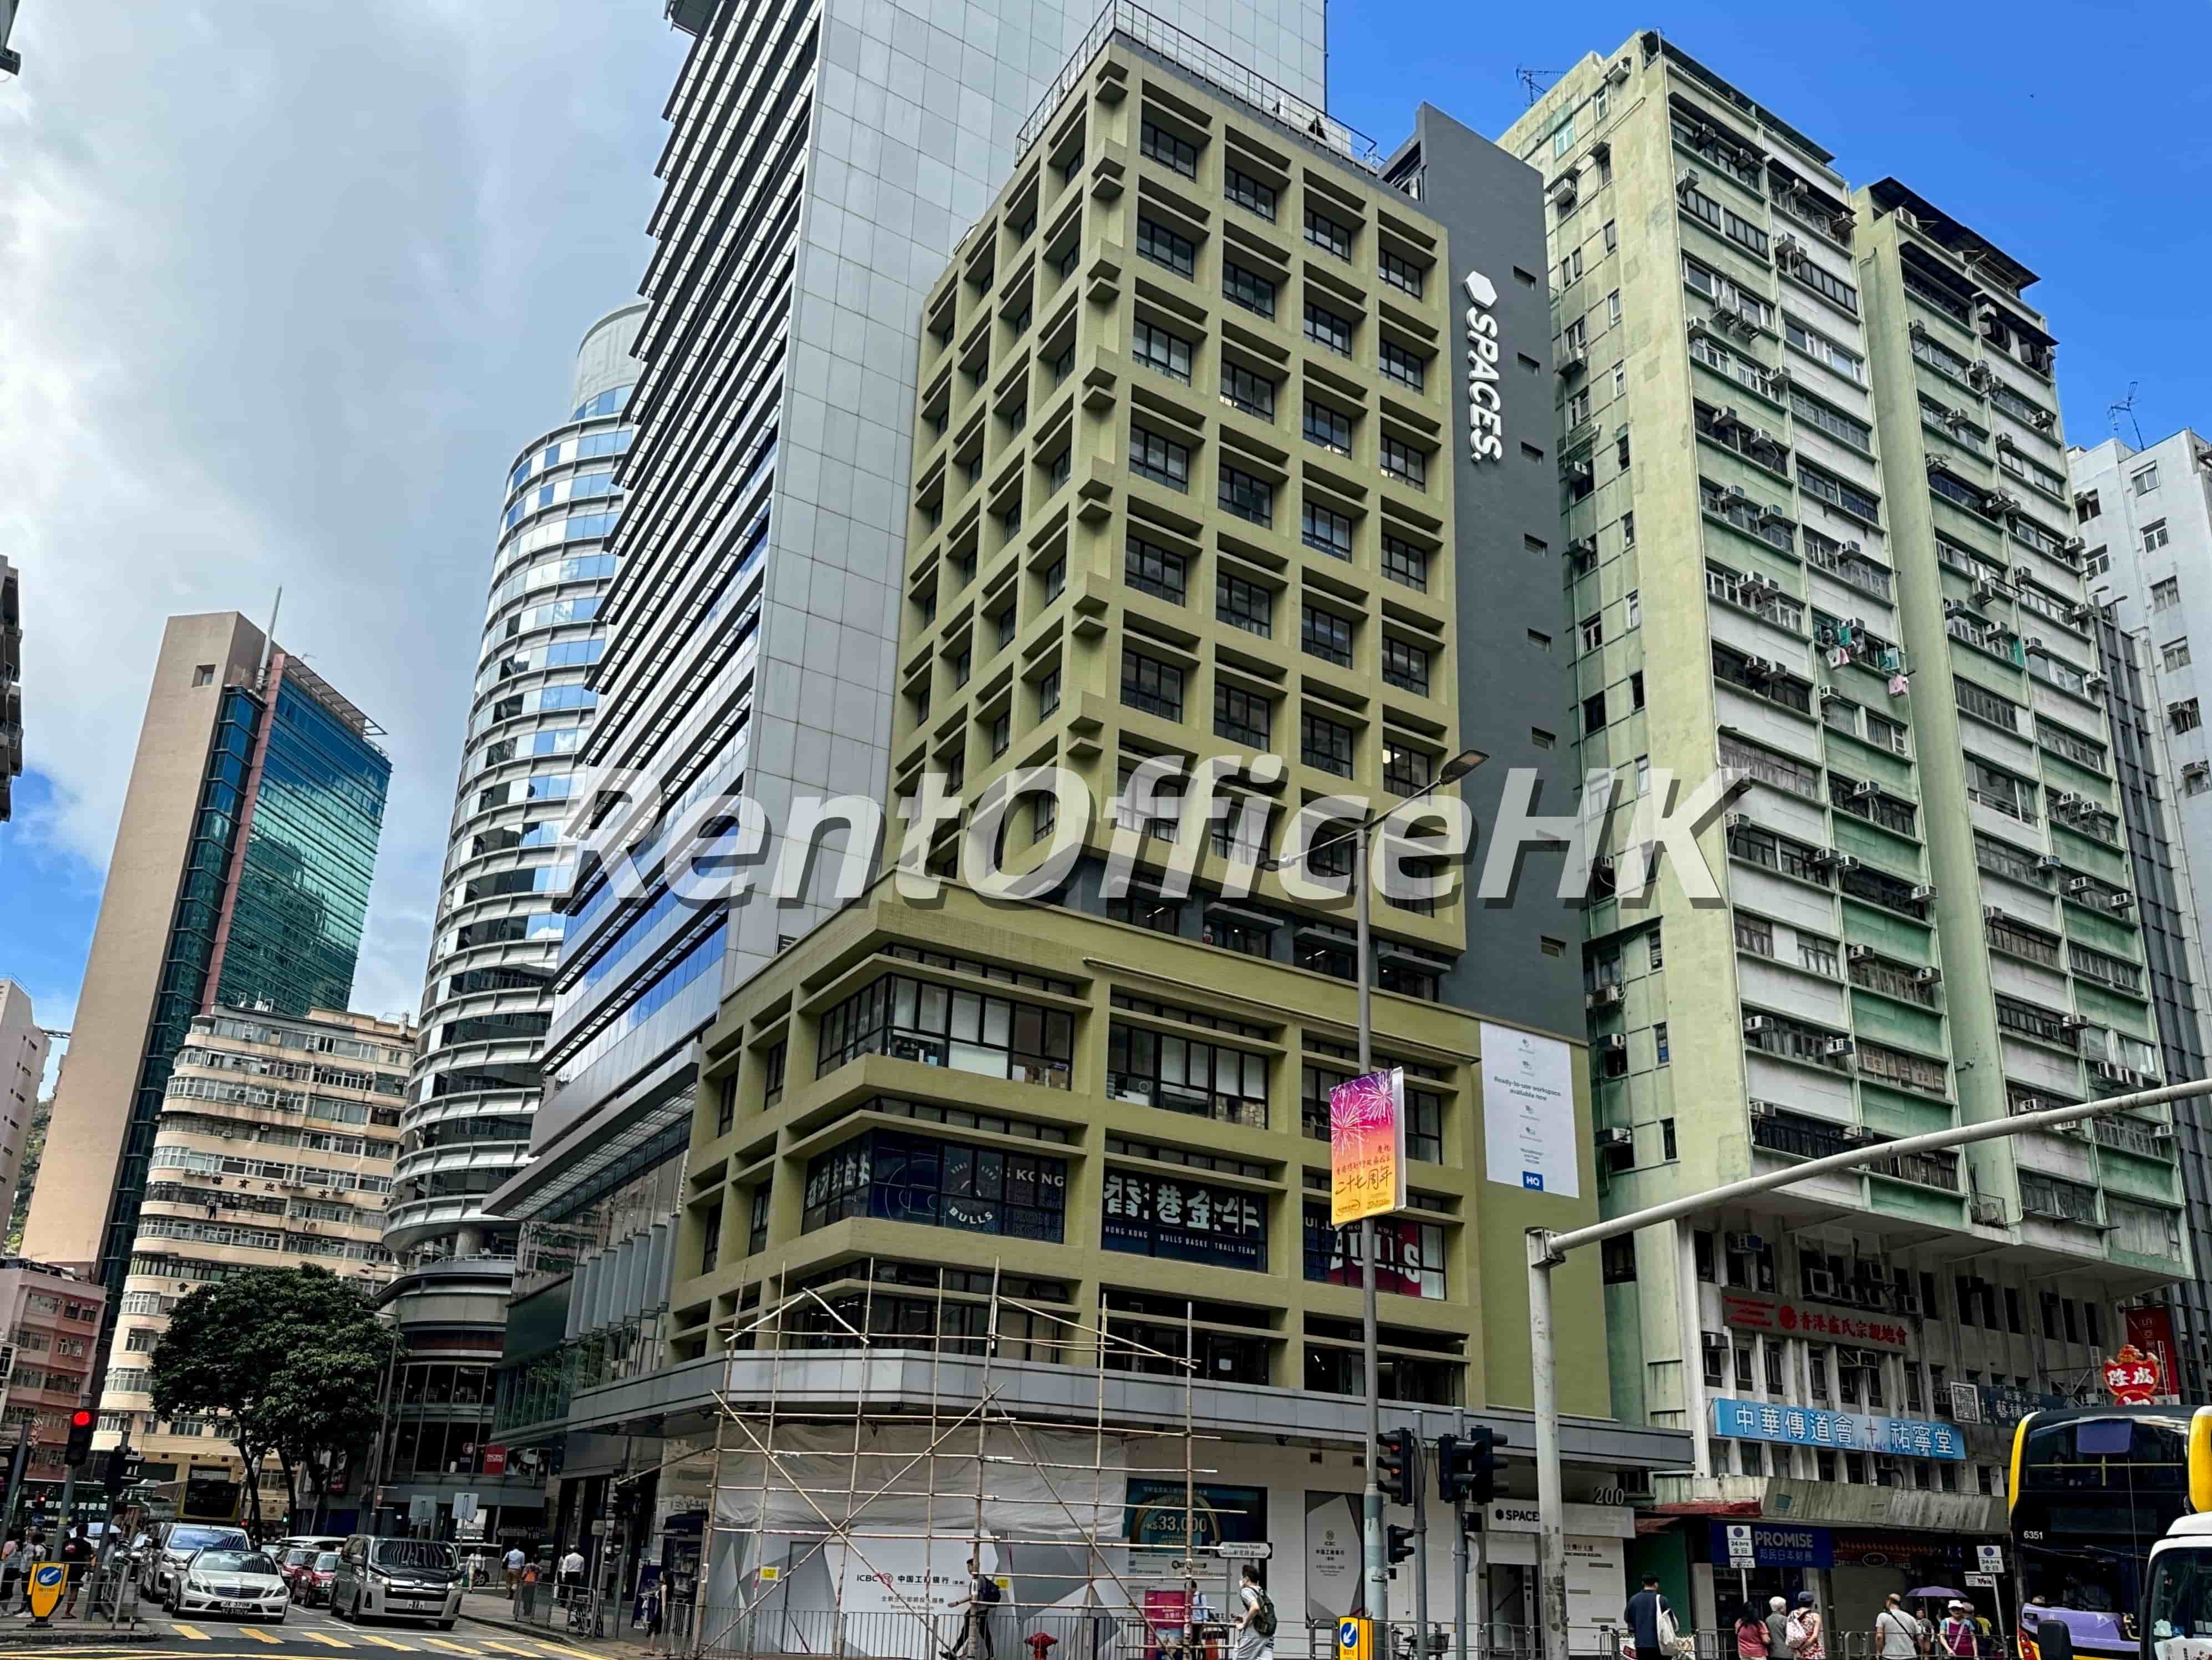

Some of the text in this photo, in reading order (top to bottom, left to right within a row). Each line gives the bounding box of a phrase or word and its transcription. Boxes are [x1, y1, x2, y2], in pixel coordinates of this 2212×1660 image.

[1526, 1175, 1540, 1186] HQ
[1103, 1175, 1260, 1234] 香港金牛
[949, 1207, 993, 1224] BULLS
[1105, 1226, 1125, 1236] HONG
[1128, 1229, 1148, 1239] KONG
[1160, 1234, 1182, 1244] BULLS
[1237, 1246, 1256, 1255] TEAM
[1735, 1404, 1954, 1455] 中華傳道會 祐寧堂
[1594, 1486, 1625, 1505] 200
[1505, 1509, 1540, 1522] SPACE
[1754, 1530, 1814, 1548] PROMISE
[2023, 1530, 2043, 1540] 6351
